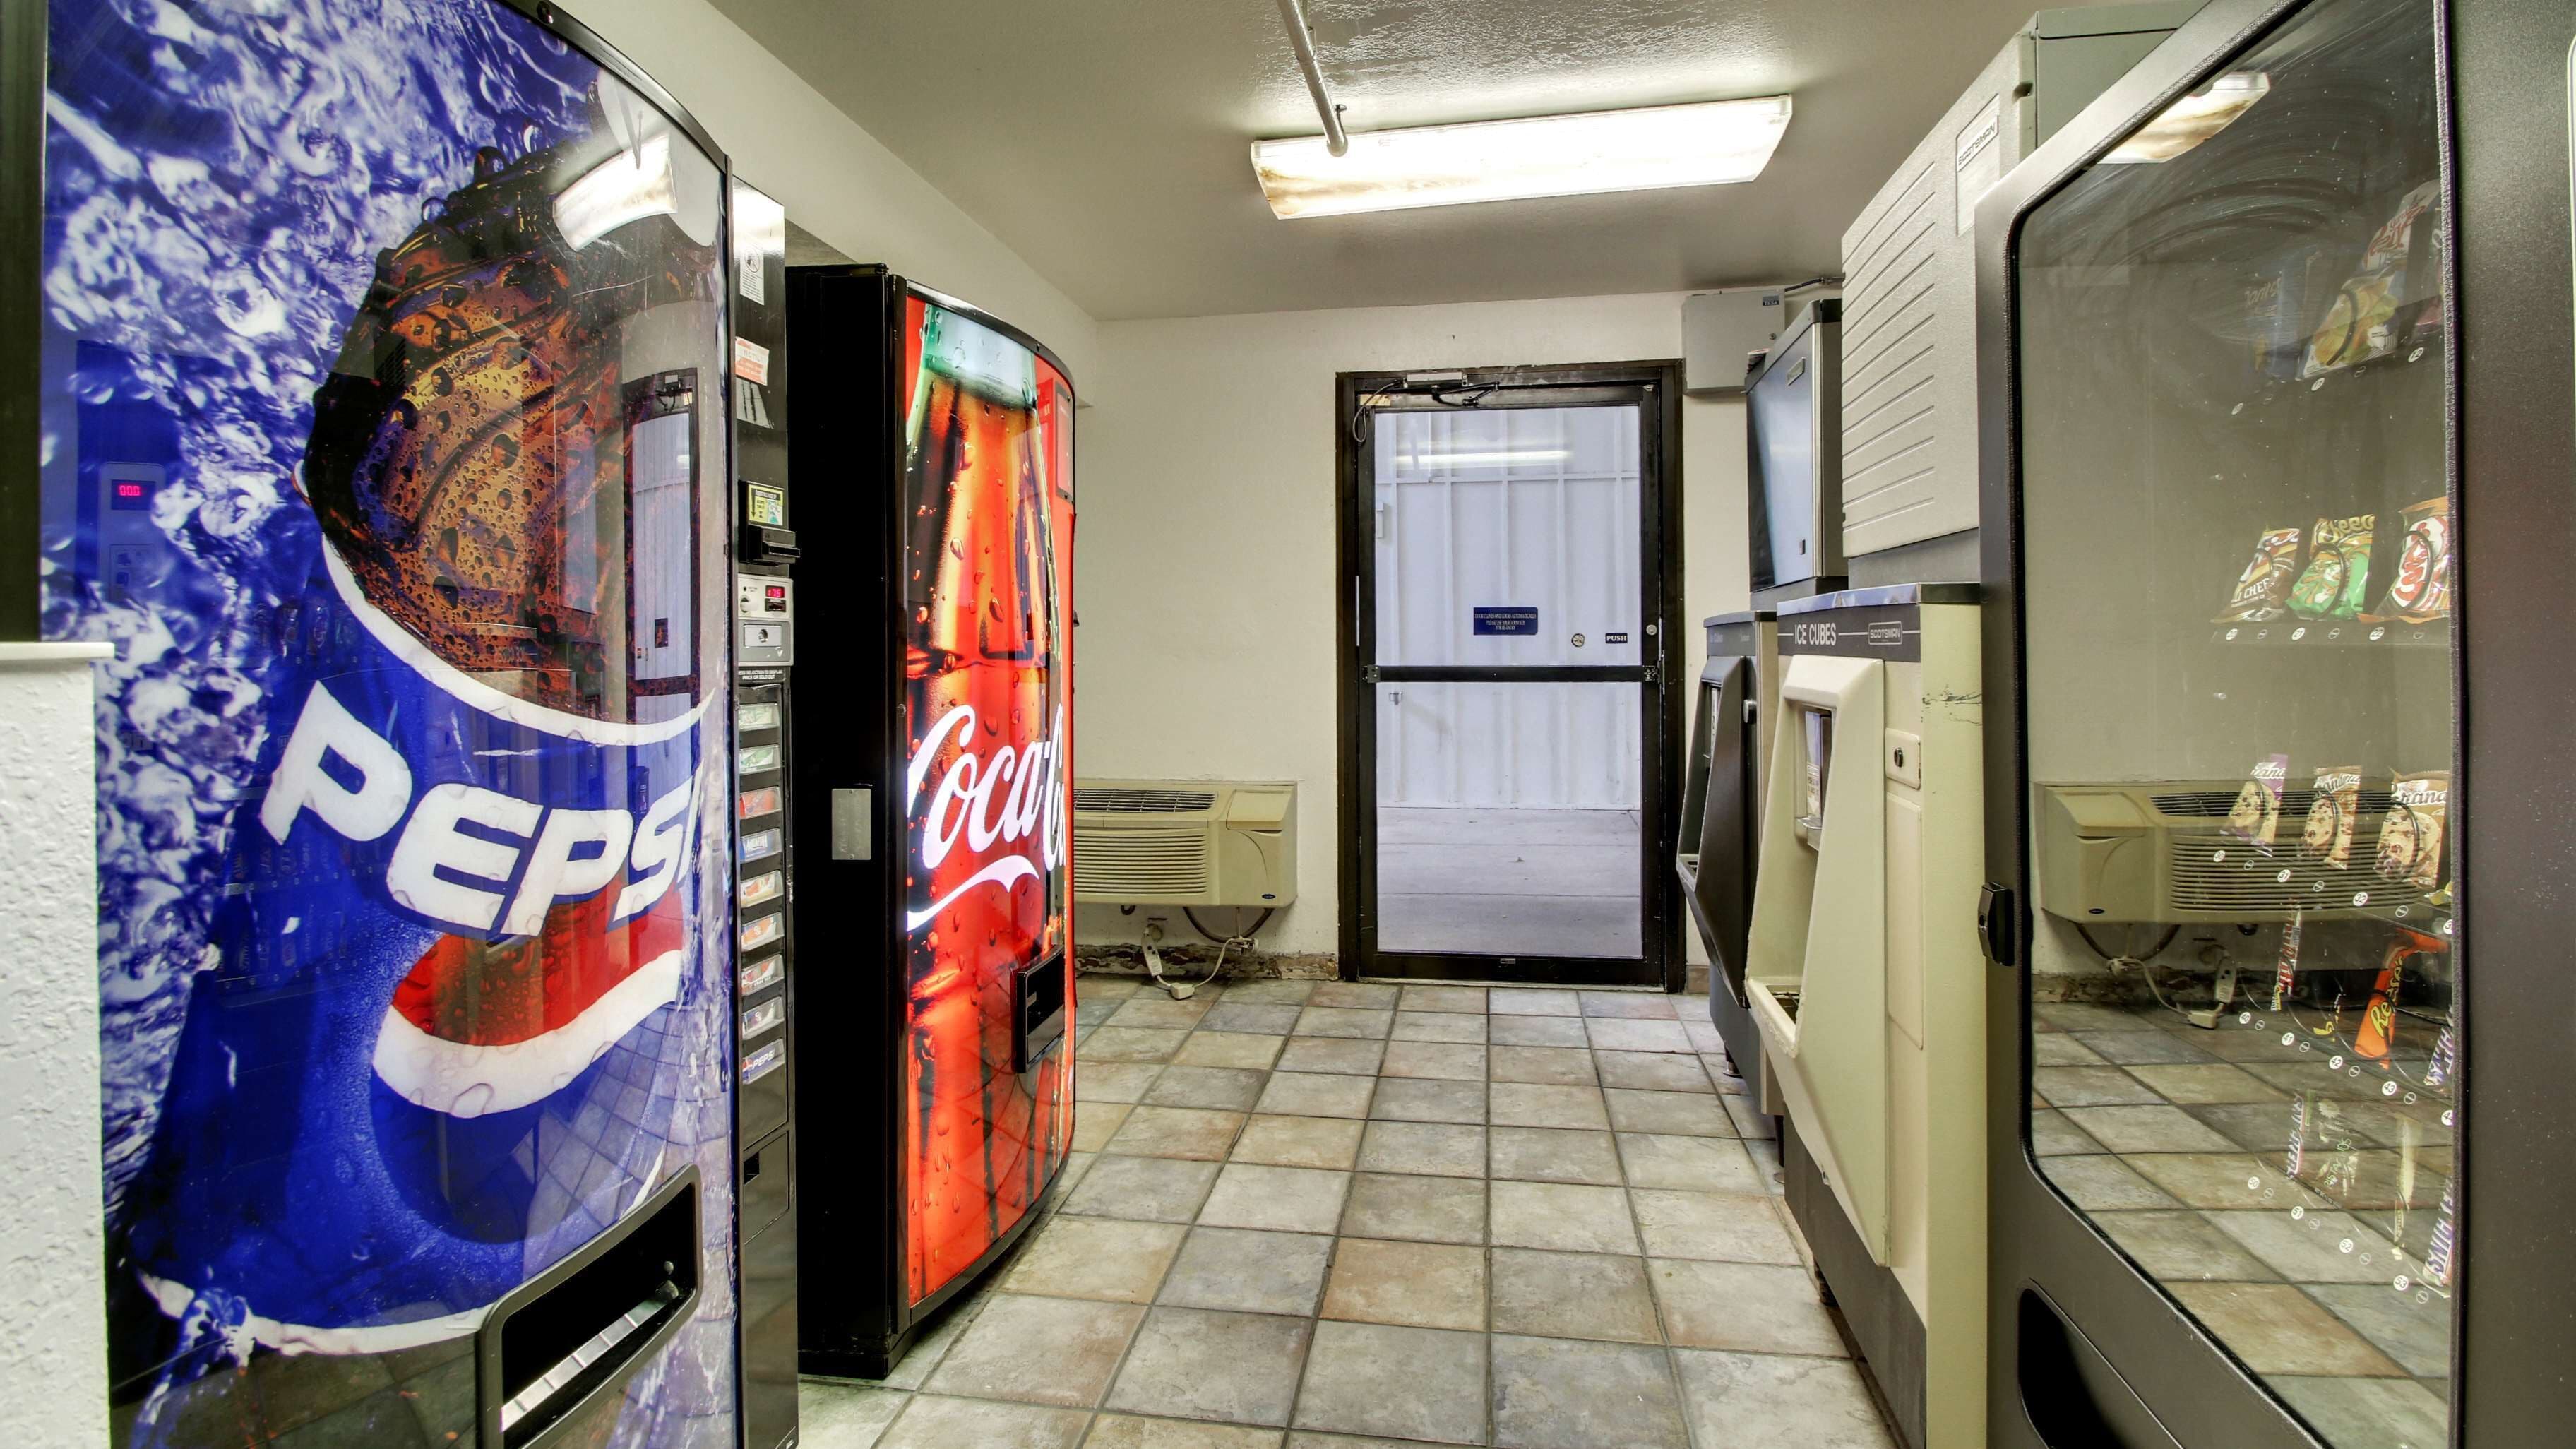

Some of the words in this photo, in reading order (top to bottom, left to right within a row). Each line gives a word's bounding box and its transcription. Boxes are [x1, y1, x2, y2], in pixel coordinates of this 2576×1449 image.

[1957, 121, 1996, 167] SCOTSMAN
[1605, 634, 1627, 643] PUSH
[1794, 624, 1807, 645] ICE
[1808, 622, 1837, 646] CUBES
[1869, 626, 1901, 639] SCOTSMAN
